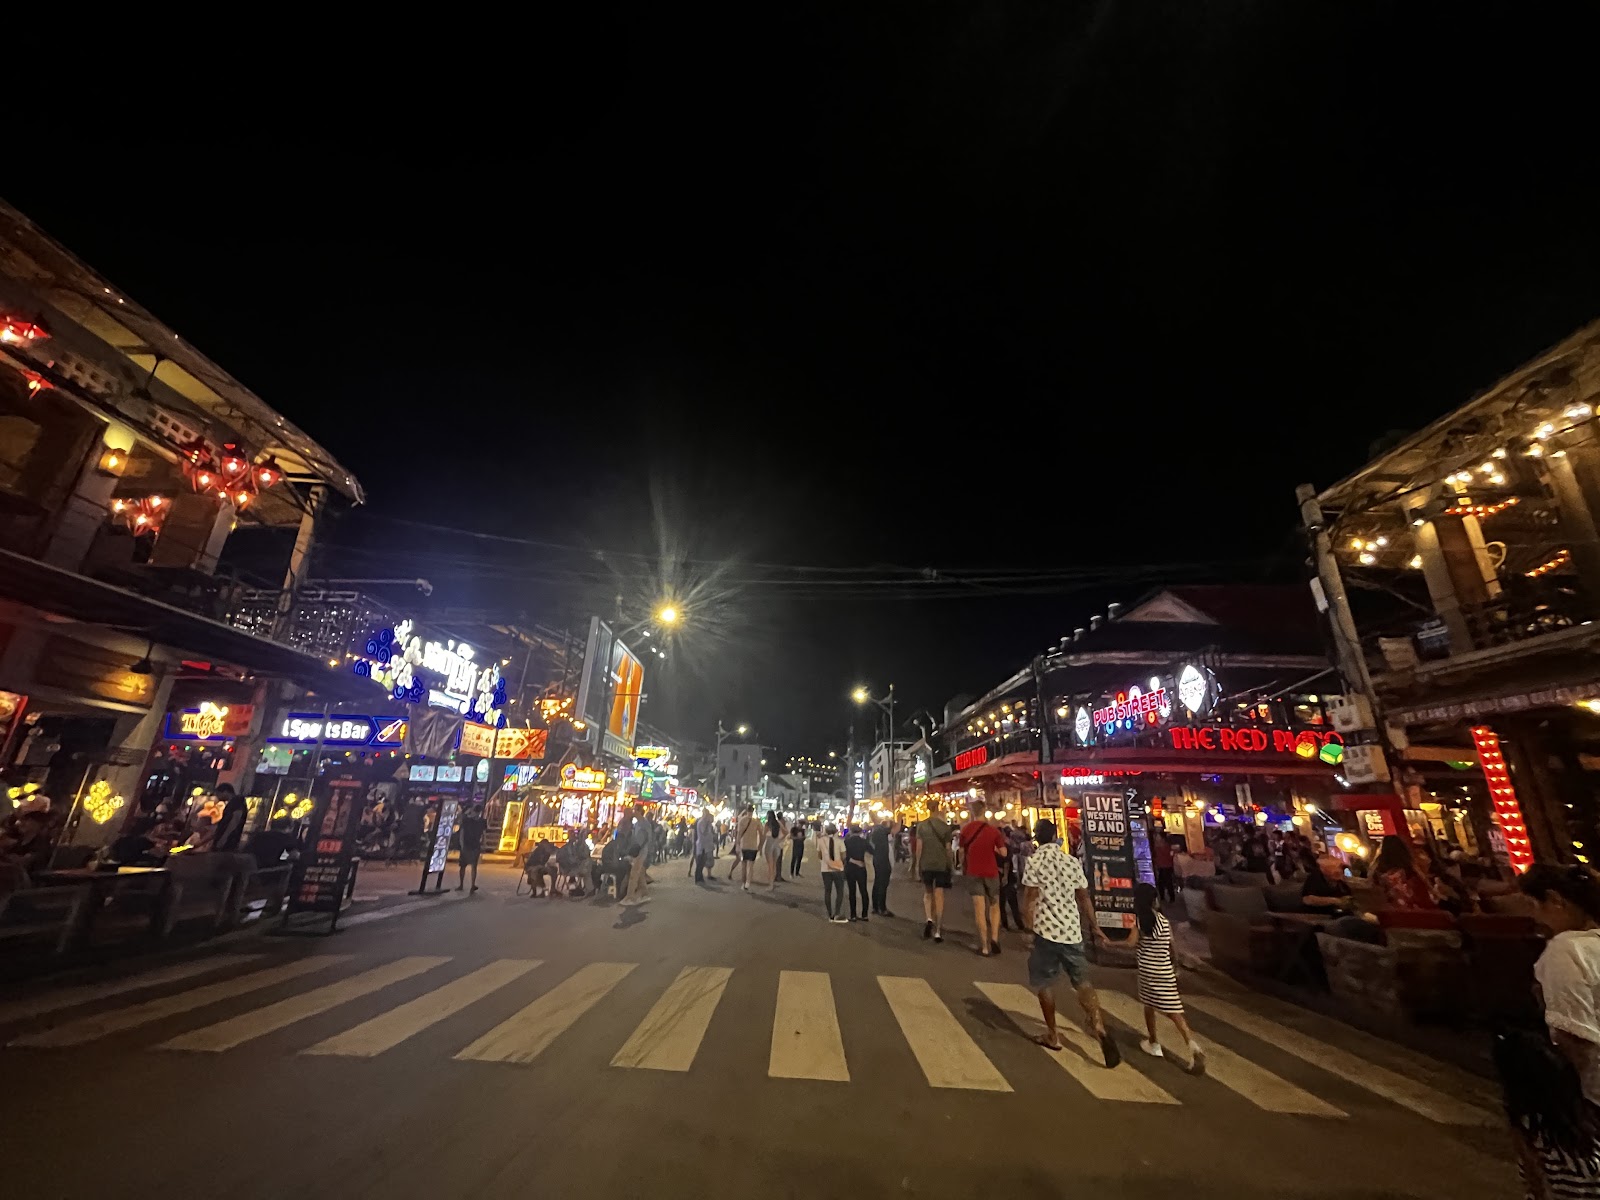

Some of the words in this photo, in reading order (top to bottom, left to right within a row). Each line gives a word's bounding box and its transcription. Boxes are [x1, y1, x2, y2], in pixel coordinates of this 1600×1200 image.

[1093, 704, 1116, 727] PUB
[1115, 687, 1168, 722] STREET
[289, 719, 341, 741] Spots
[341, 721, 370, 740] Bar
[1168, 727, 1216, 750] THE
[1220, 728, 1267, 751] RED
[1085, 796, 1122, 812] LIVE
[1087, 811, 1124, 821] WESTERN
[1088, 821, 1125, 833] BAND
[1090, 836, 1125, 847] UPSTAIRS
